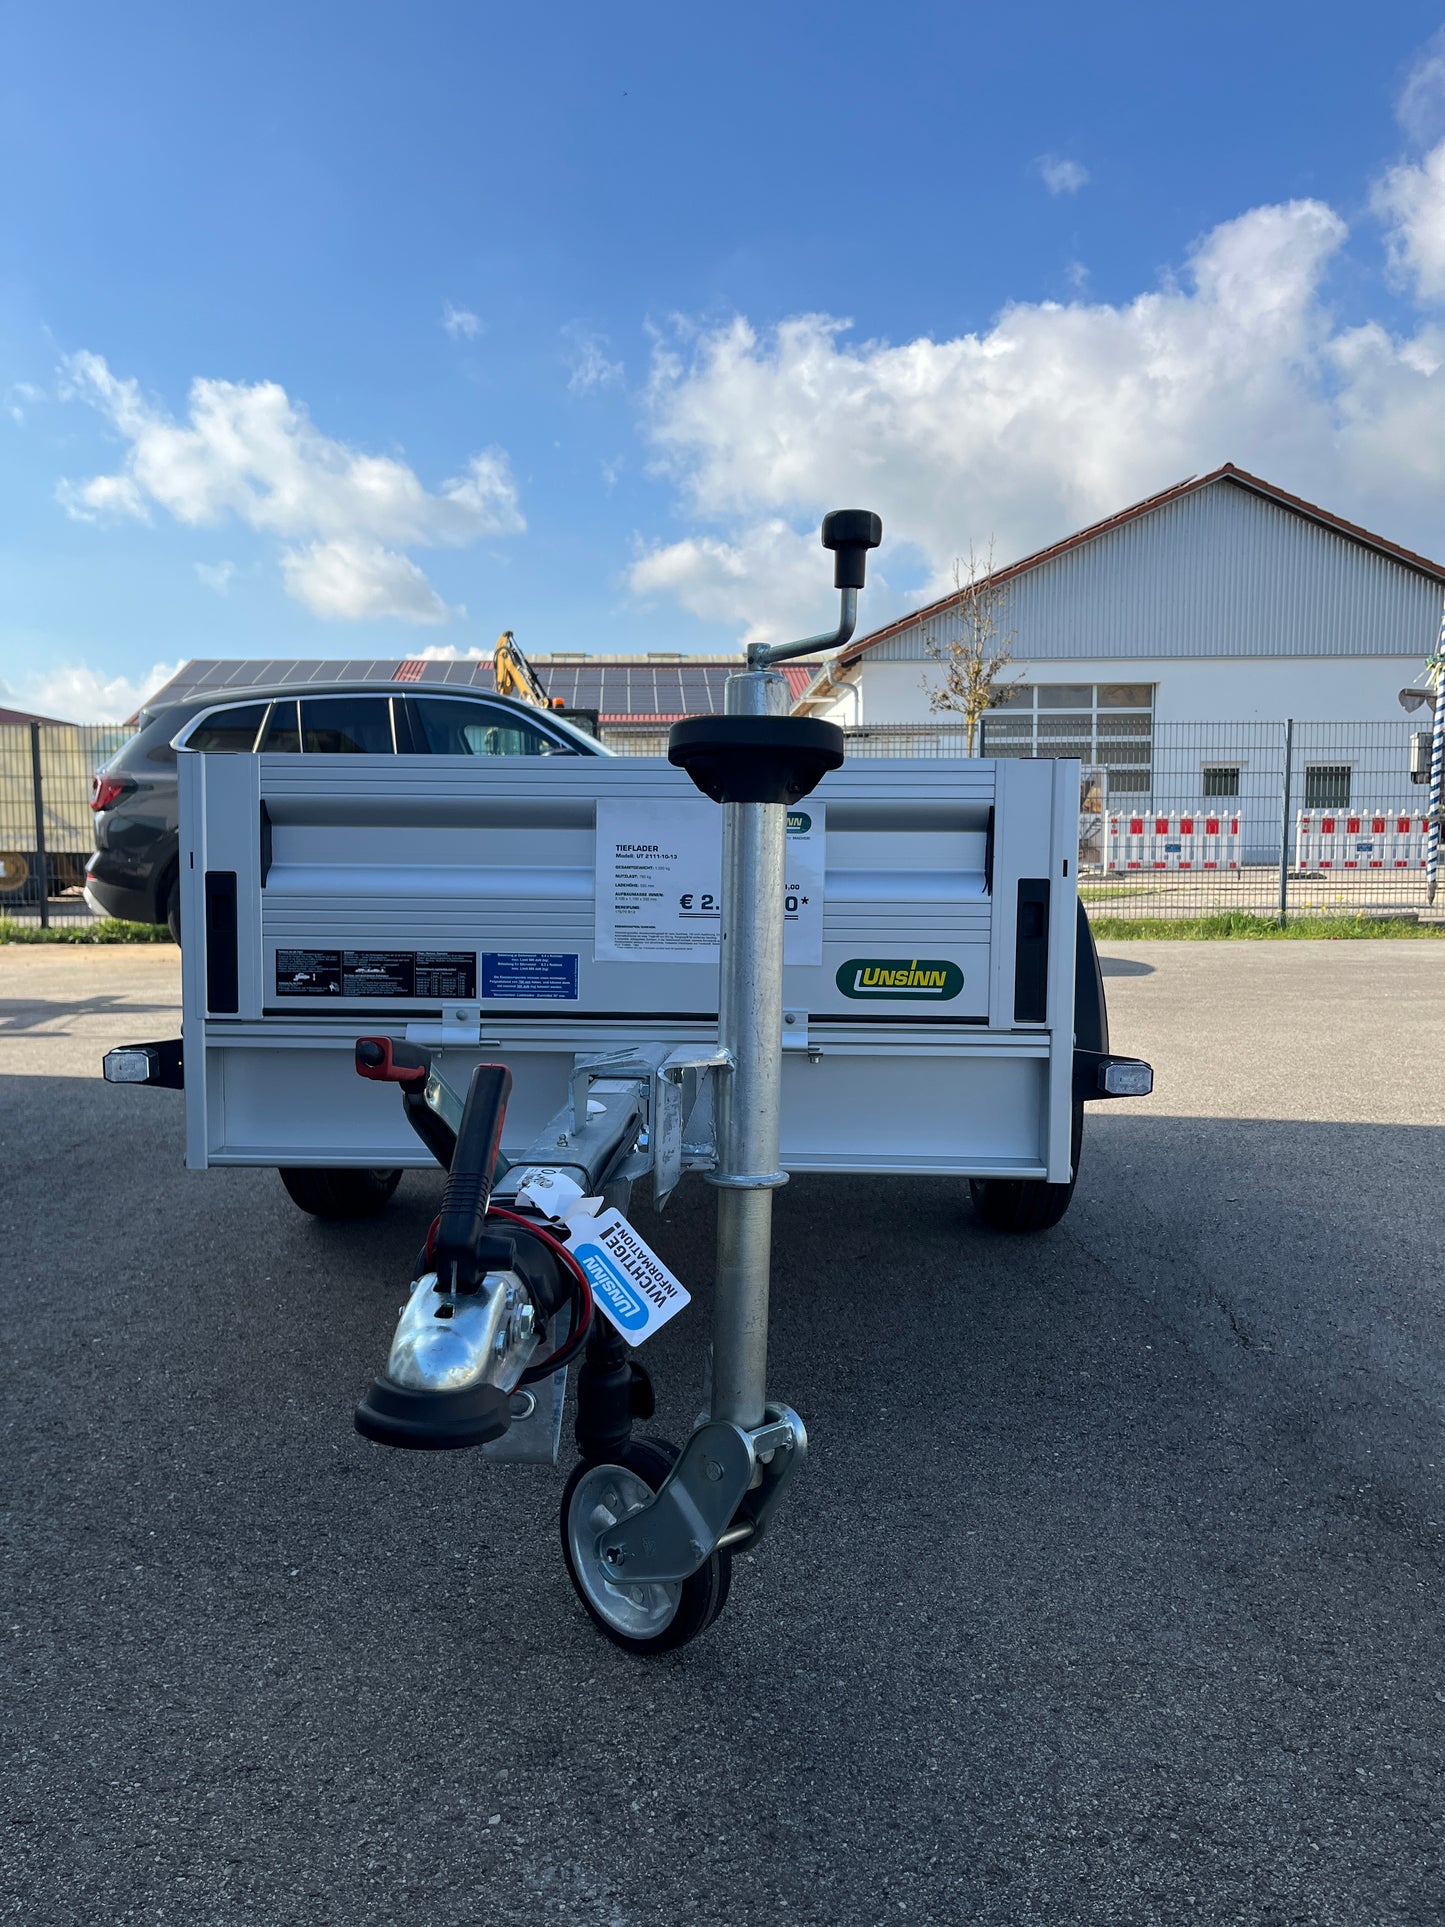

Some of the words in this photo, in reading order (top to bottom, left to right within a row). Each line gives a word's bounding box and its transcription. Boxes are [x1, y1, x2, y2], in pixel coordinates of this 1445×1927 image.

[615, 844, 659, 852] TIEFLADER
[680, 894, 693, 910] €
[582, 1256, 638, 1318] UNSINN
[599, 1221, 667, 1308] WICHTIGE!
[617, 1228, 678, 1298] INFORMATION
